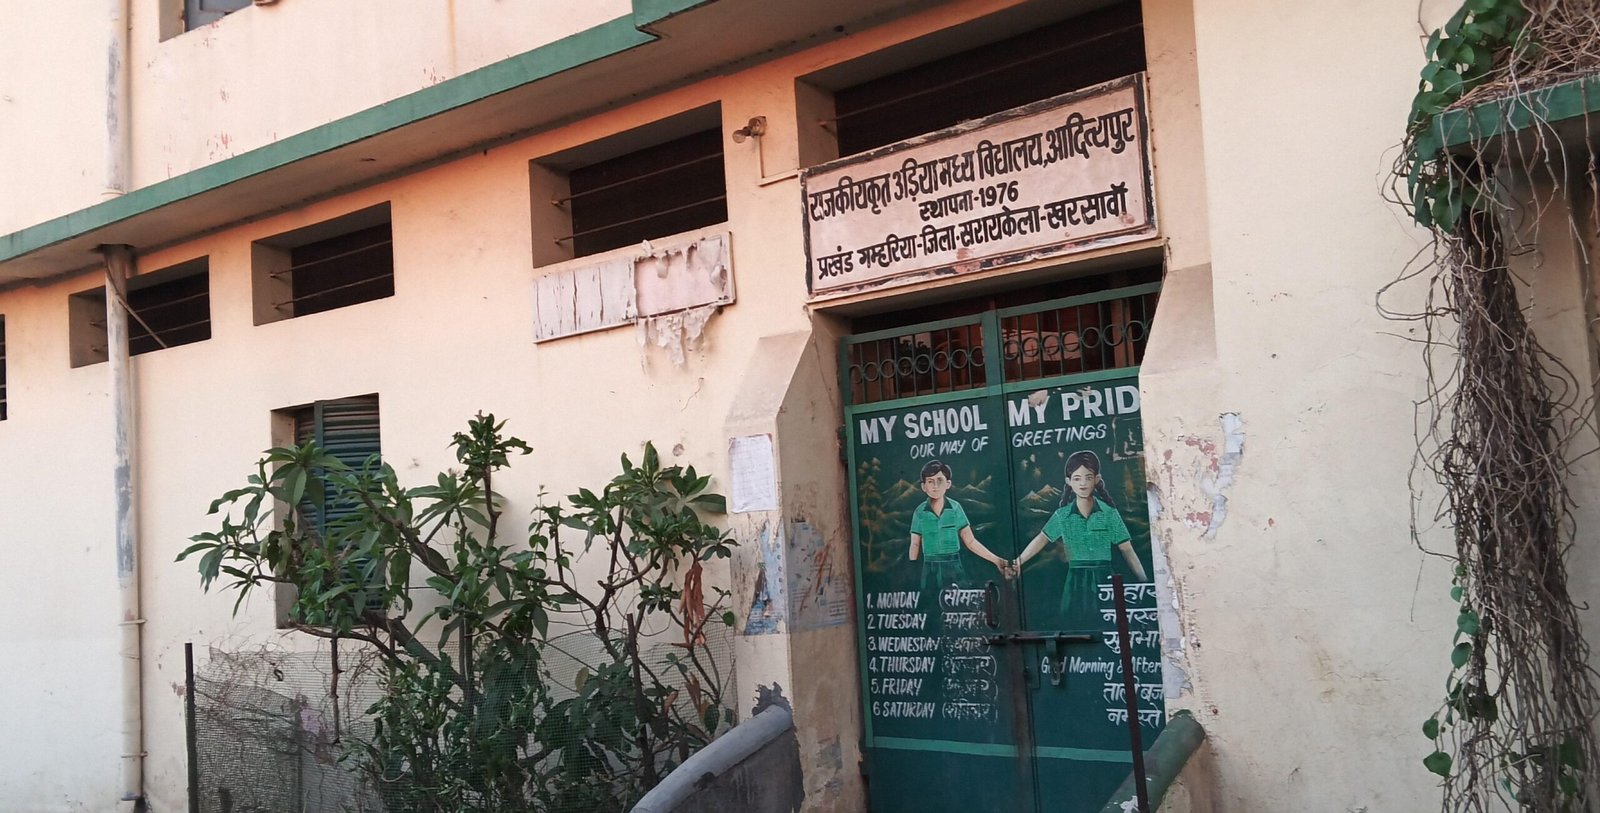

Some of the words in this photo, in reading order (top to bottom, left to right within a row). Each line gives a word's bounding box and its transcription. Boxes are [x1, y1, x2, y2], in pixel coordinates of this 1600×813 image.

[809, 176, 891, 221] राजकीयकृत
[939, 151, 975, 187] मध्य
[817, 245, 854, 279] प्रखंड
[859, 415, 897, 444] MY
[903, 405, 988, 438] SCHOOL
[1008, 395, 1050, 427] MY
[1061, 385, 1140, 420] PRID
[910, 442, 935, 459] OUR
[939, 440, 966, 456] WAY
[971, 436, 989, 452] OF
[1012, 423, 1107, 448] GREETINGS
[877, 591, 920, 609] MONDAY
[877, 613, 927, 630] TUESDAY
[878, 637, 940, 652] WEDNESDAY
[879, 656, 936, 673] THURSDAY
[1069, 656, 1114, 680] Morning
[882, 678, 922, 696] FRIDAY
[882, 701, 936, 719] SATURDAY
